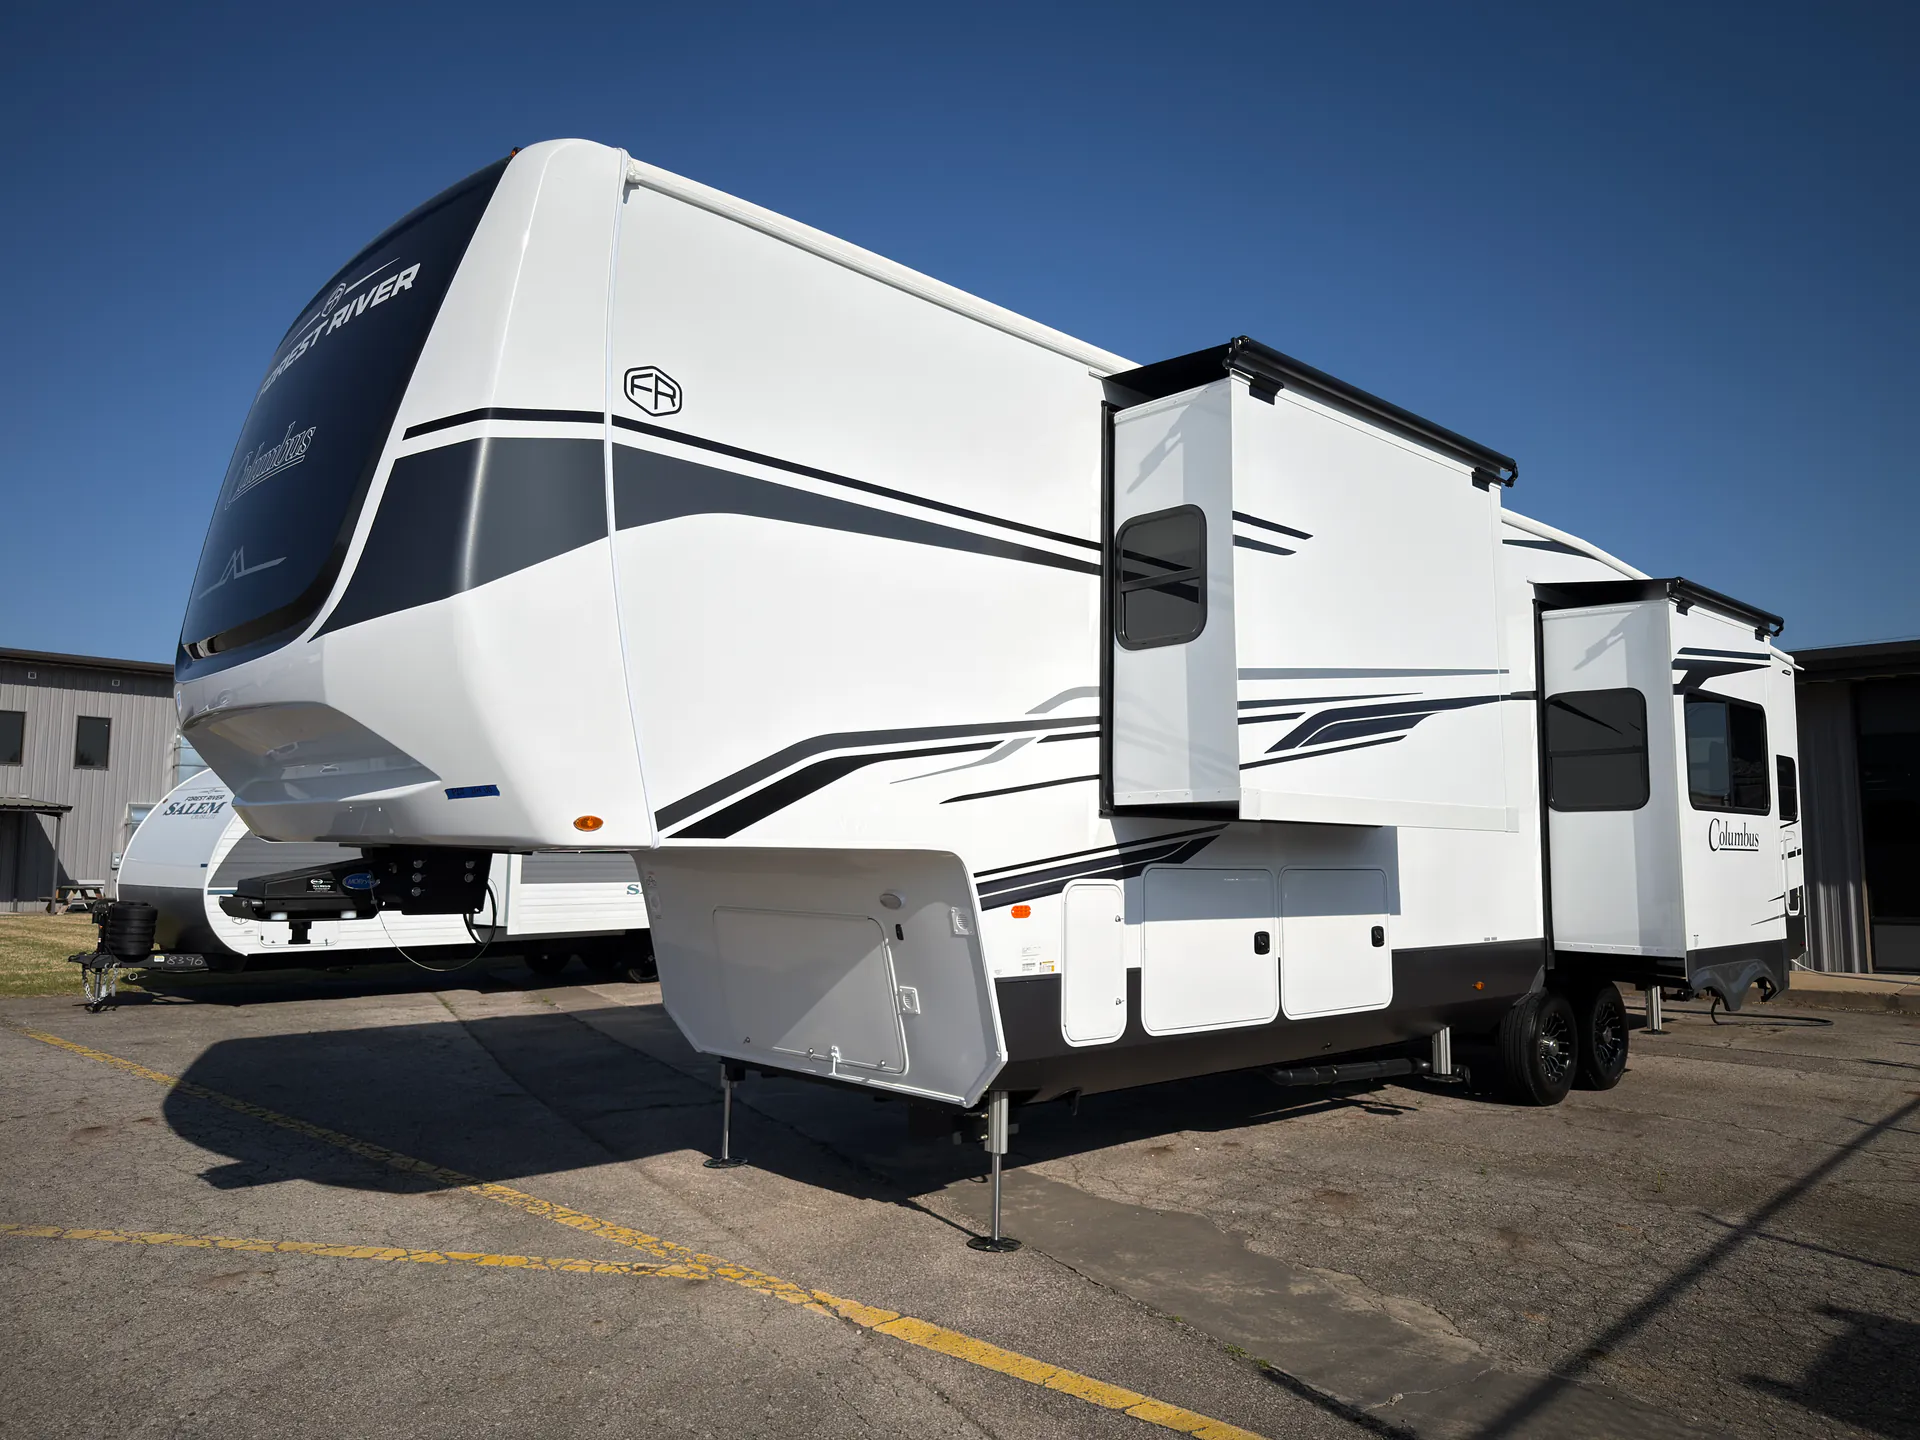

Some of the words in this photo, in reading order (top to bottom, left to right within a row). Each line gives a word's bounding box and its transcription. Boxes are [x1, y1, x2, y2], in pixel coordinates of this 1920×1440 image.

[256, 319, 329, 404] FOREST
[326, 262, 421, 336] RIVER
[224, 420, 317, 511] Columbus
[163, 802, 228, 816] SALEM
[1708, 817, 1760, 852] Columbus
[166, 955, 203, 966] 8396
